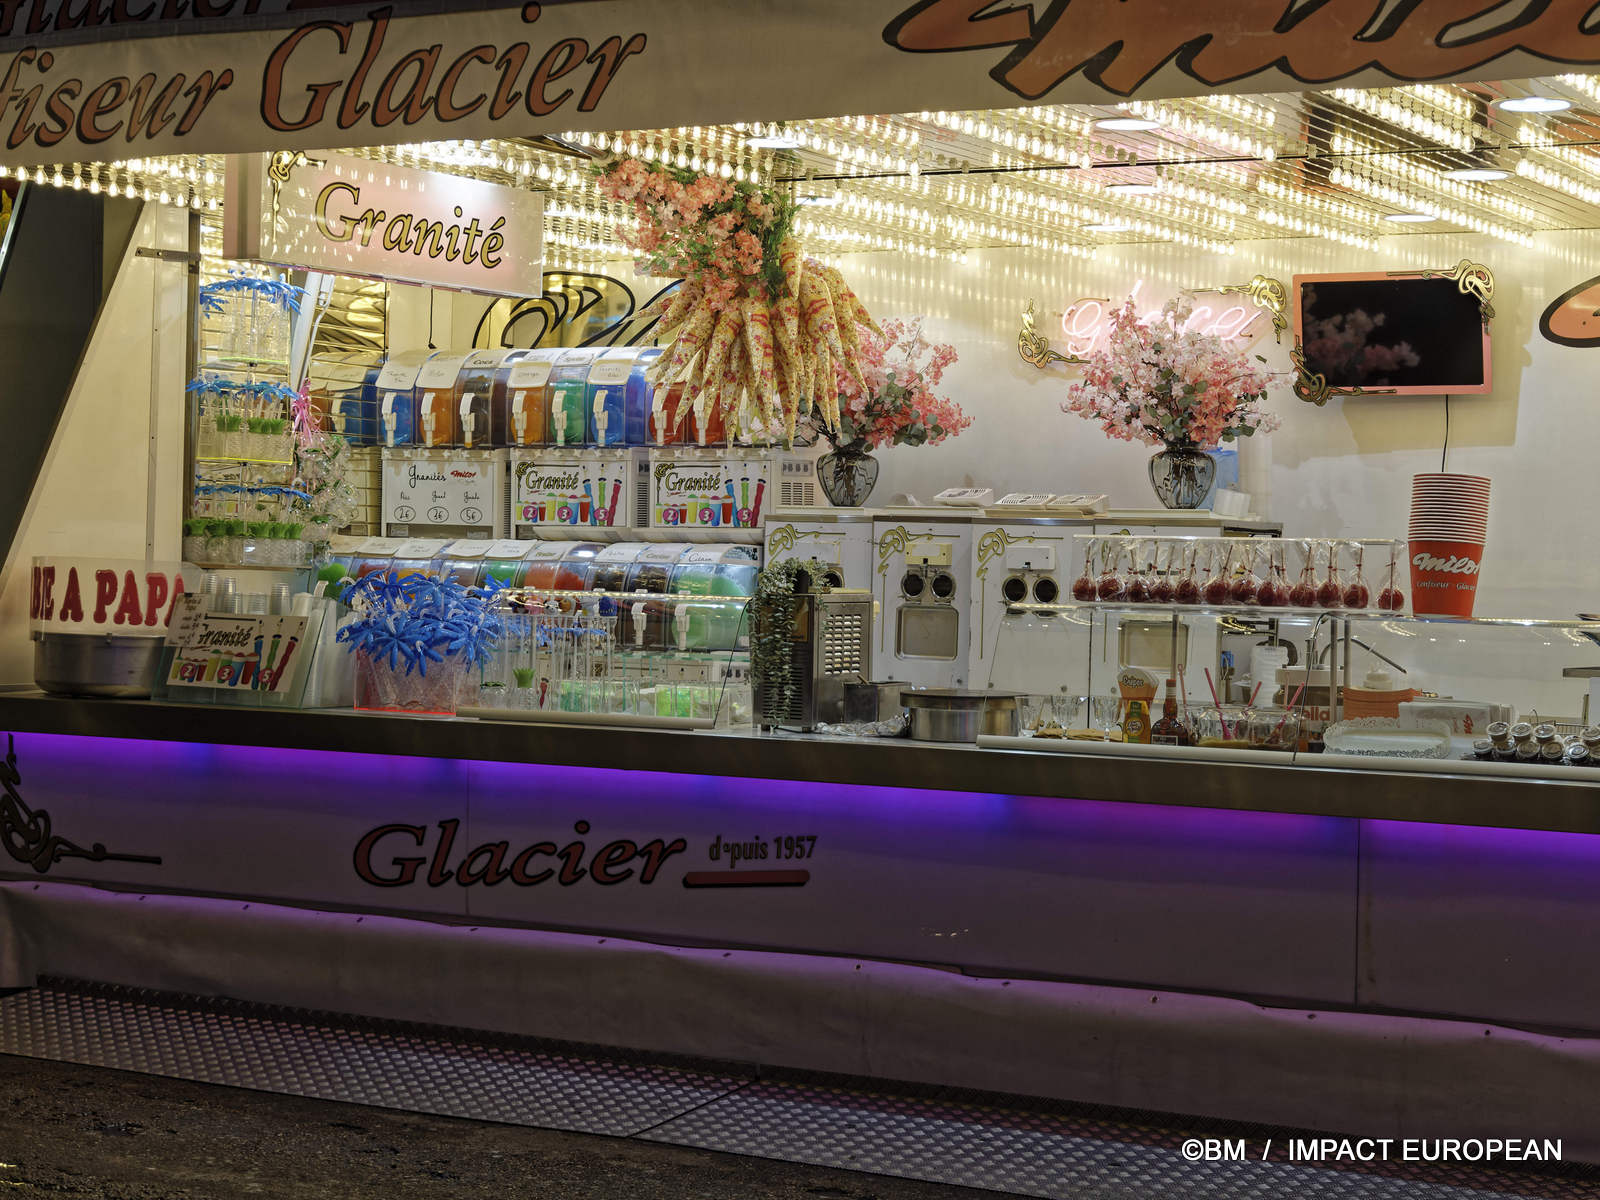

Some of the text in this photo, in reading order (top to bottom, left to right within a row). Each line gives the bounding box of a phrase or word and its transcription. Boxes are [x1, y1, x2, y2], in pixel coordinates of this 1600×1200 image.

[260, 2, 647, 132] Glacier
[314, 183, 506, 270] Granité
[525, 470, 580, 490] Granité
[664, 471, 720, 491] Granité
[60, 566, 83, 622] A
[353, 819, 687, 887] Glacier
[774, 835, 818, 860] 1957
